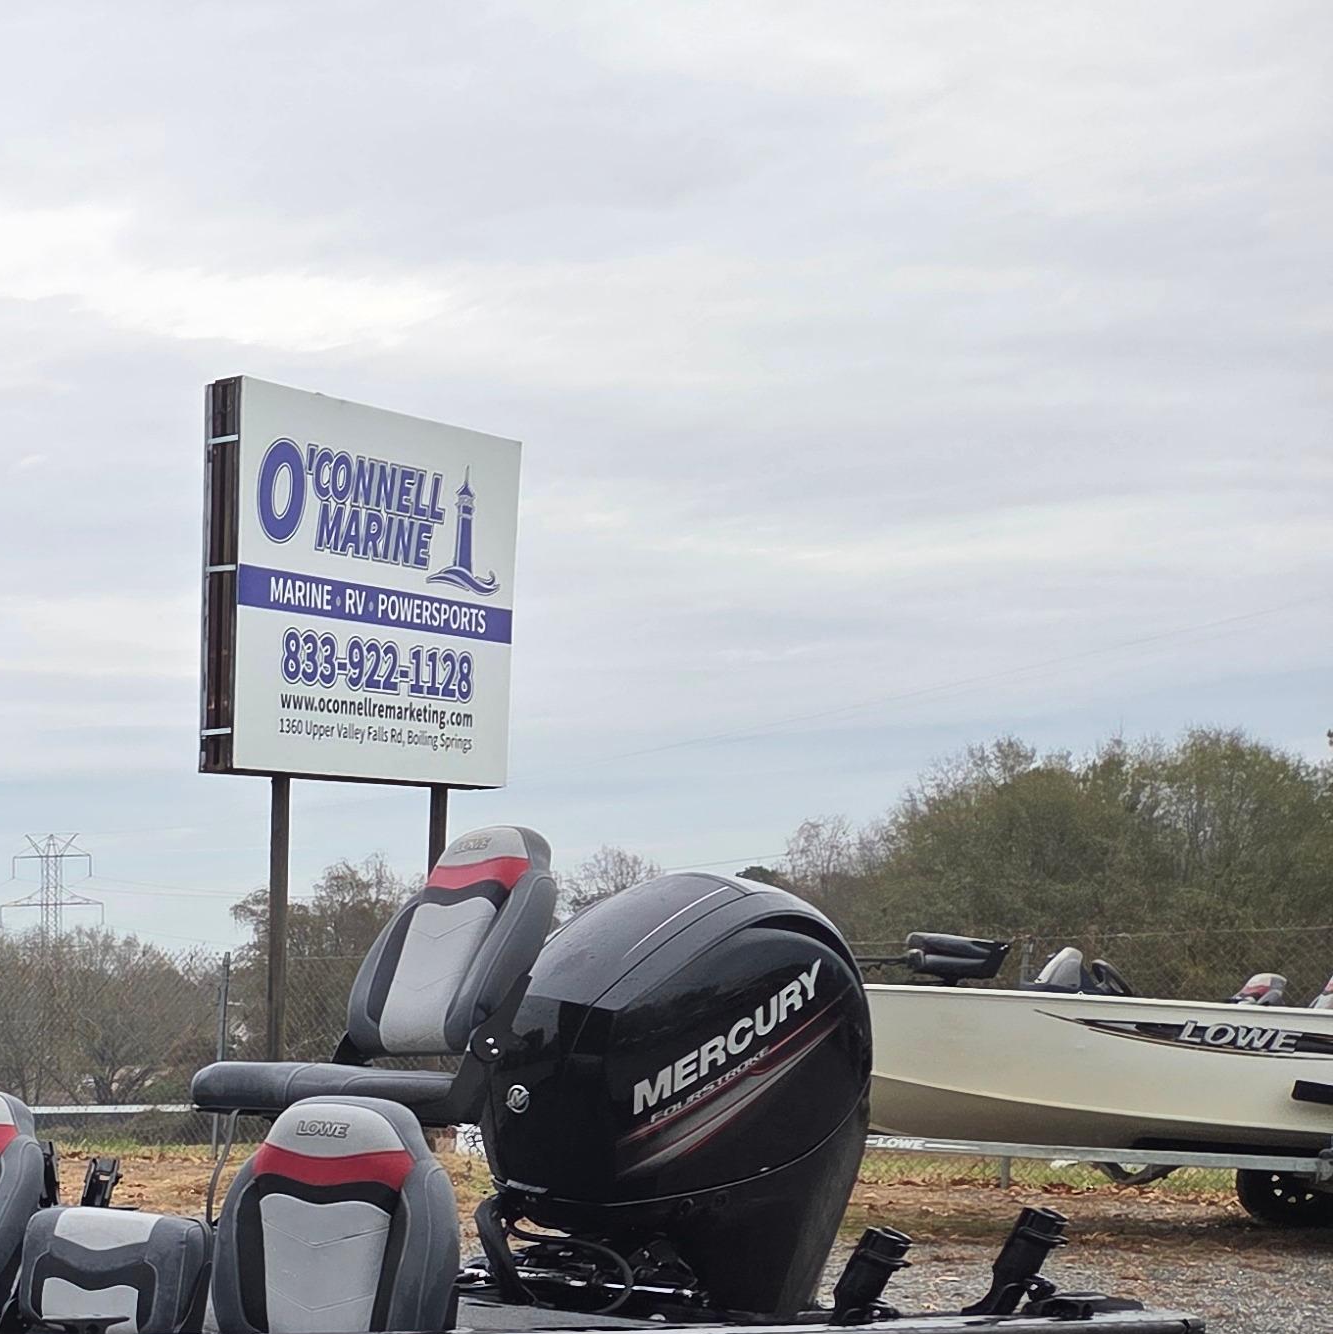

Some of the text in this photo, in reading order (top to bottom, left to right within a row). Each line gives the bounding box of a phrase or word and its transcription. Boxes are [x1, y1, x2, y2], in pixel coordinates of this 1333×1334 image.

[257, 437, 445, 546] O'CONNELL
[314, 501, 435, 571] MARINE
[270, 576, 486, 634] MARINE RV POWERSPORTS
[281, 627, 473, 704] 833-922-1128
[279, 718, 303, 735] 1360
[305, 720, 334, 740] Upper
[336, 723, 365, 744] Valley
[367, 726, 389, 743] Falls
[440, 733, 473, 754] Springs
[280, 693, 473, 729] www.oconnellremarketing.com
[633, 958, 822, 1115] MERCURY
[1178, 1020, 1303, 1054] LOWE
[650, 1046, 770, 1124] FOURSTROKE
[296, 1120, 351, 1139] LOWE
[876, 1136, 926, 1150] LOWE
